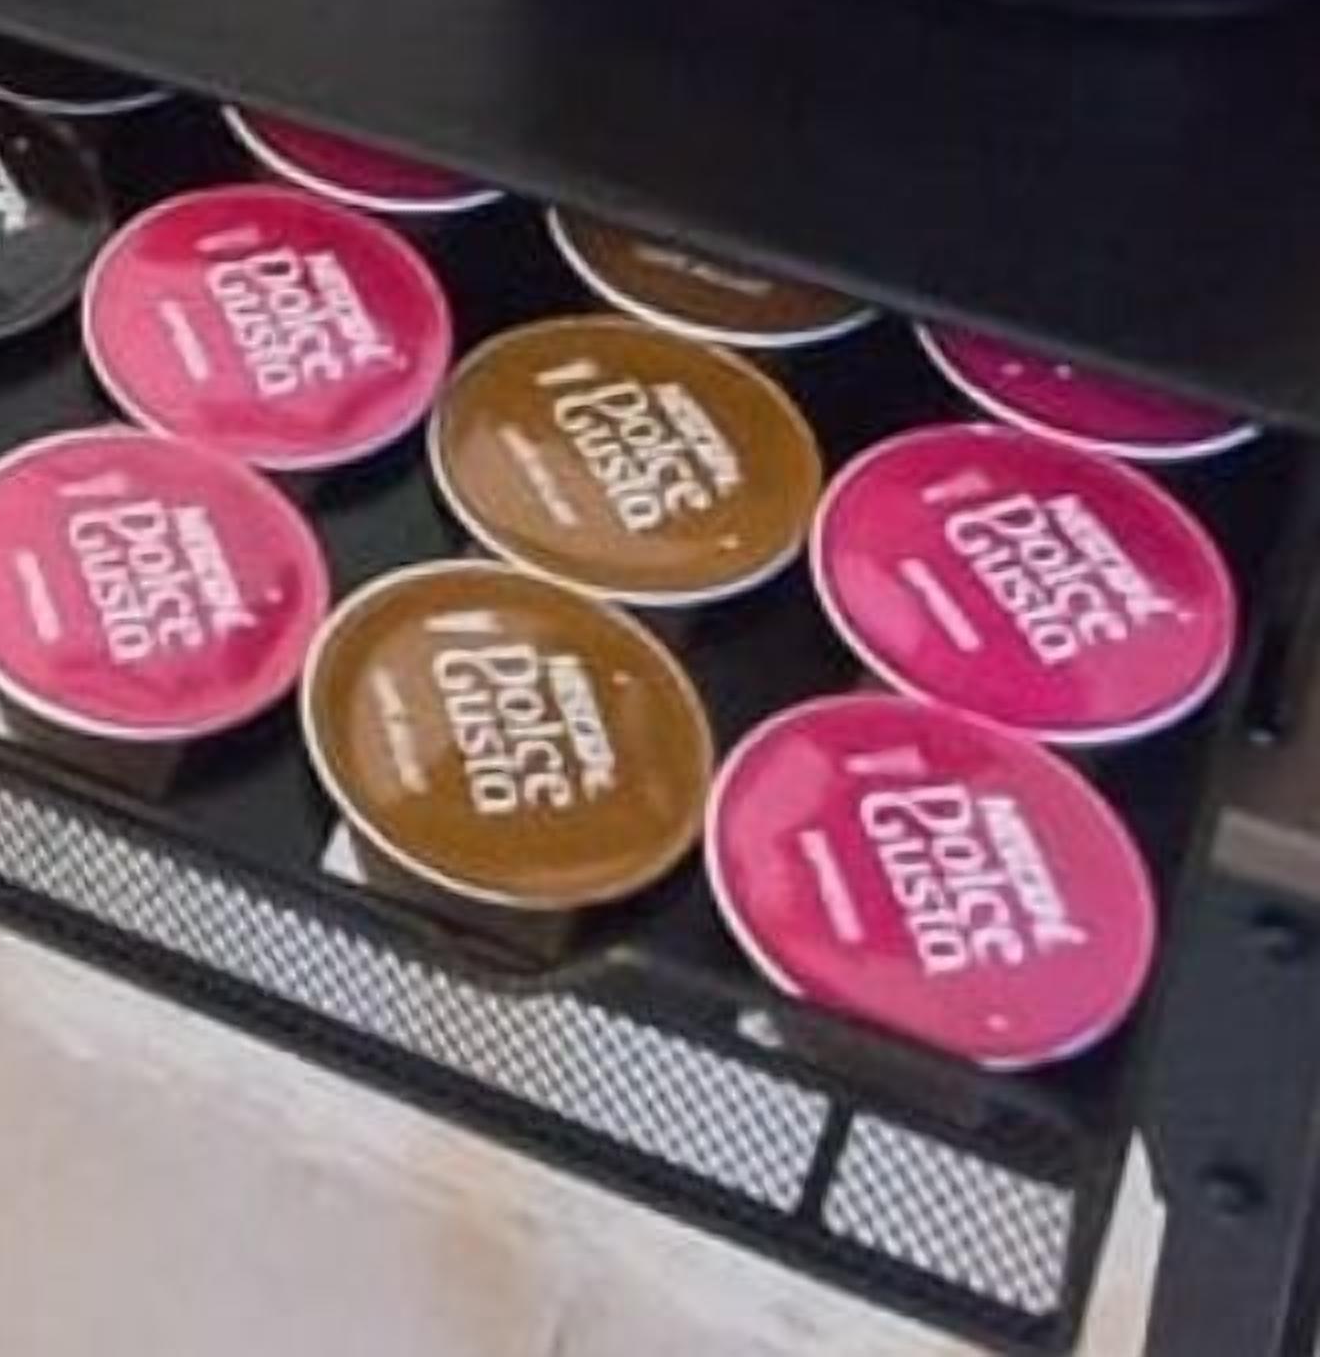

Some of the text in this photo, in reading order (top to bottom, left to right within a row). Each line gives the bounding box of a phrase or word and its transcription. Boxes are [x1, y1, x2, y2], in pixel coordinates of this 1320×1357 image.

[205, 261, 299, 397] Gusto
[249, 247, 343, 383] Dolce
[553, 397, 661, 534] Gusto
[593, 380, 711, 516] Dolce
[68, 509, 157, 664] Gusto
[109, 499, 203, 650] Dolce
[943, 510, 1080, 666] Gusto
[990, 492, 1129, 647] Dolce
[432, 649, 519, 813] Gusto
[482, 644, 572, 810] Dolce
[860, 791, 967, 977] Gusto
[906, 782, 1025, 969] Dolce
